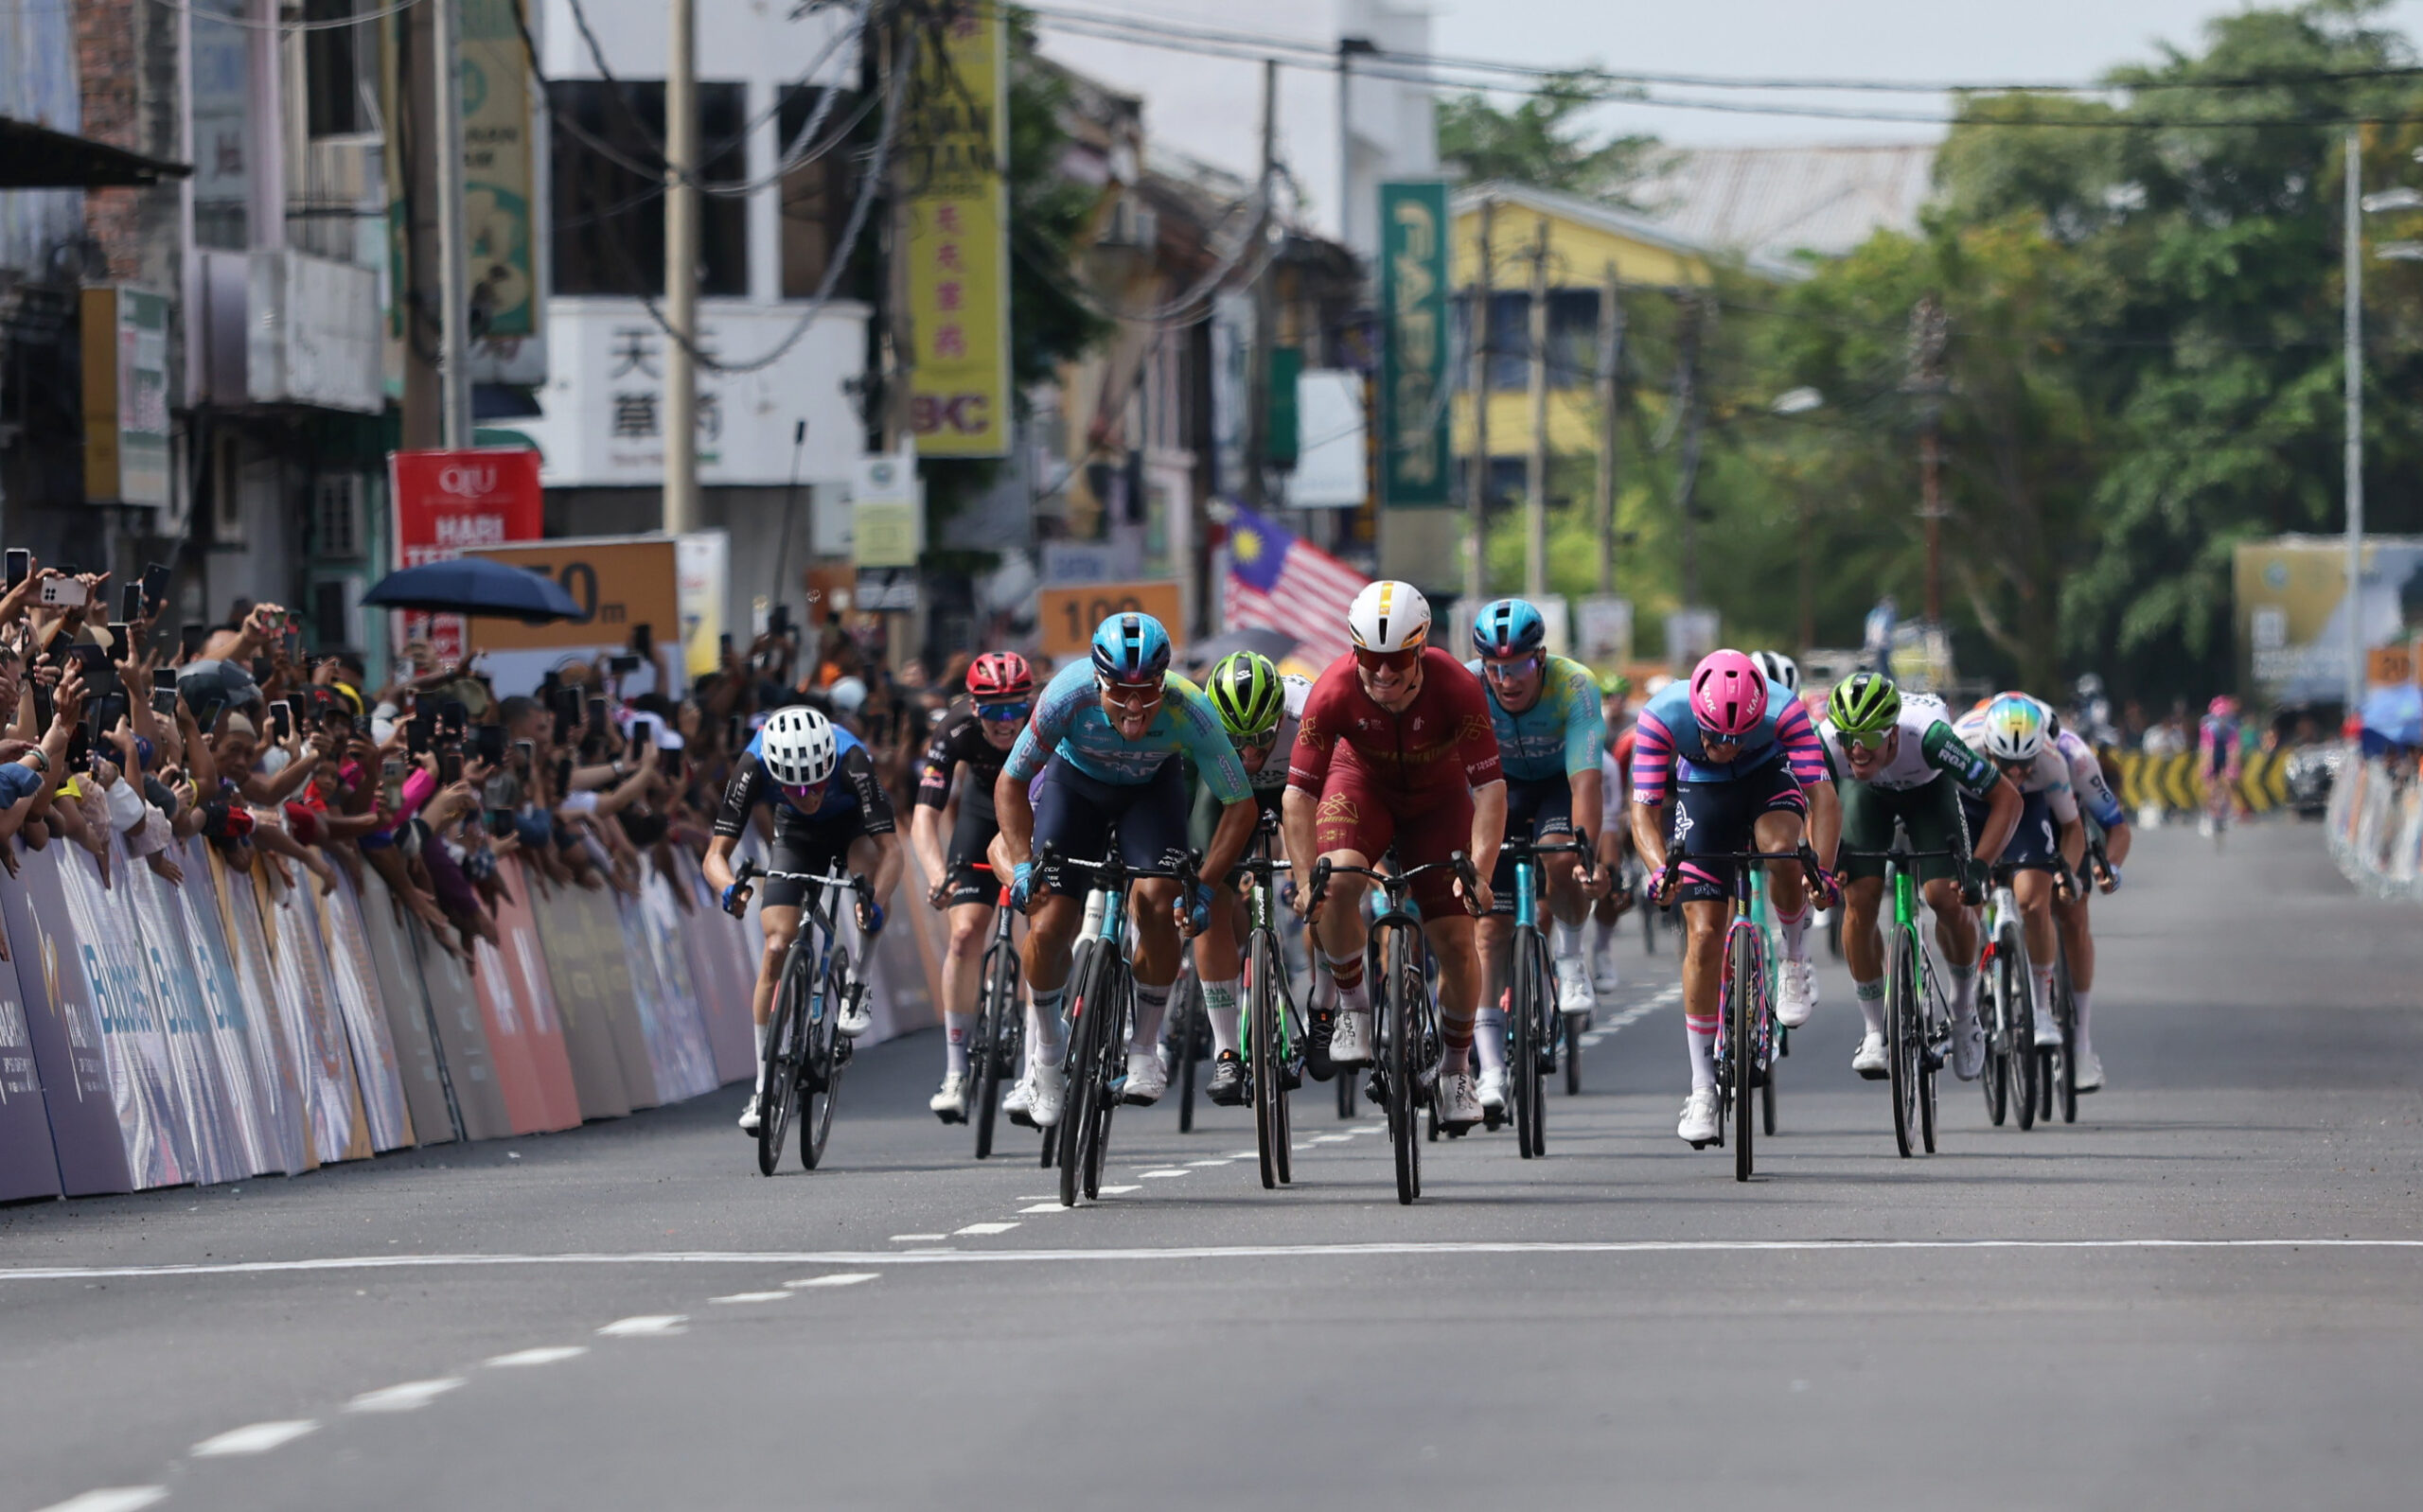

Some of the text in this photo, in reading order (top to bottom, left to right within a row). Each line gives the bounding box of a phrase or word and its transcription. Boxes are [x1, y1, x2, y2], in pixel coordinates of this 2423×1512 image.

[435, 515, 505, 543] HARI
[600, 604, 627, 624] m
[1703, 683, 1717, 714] KASK
[1746, 686, 1761, 715] KASK
[1937, 747, 1967, 771] RGA
[999, 909, 1010, 937] BMC
